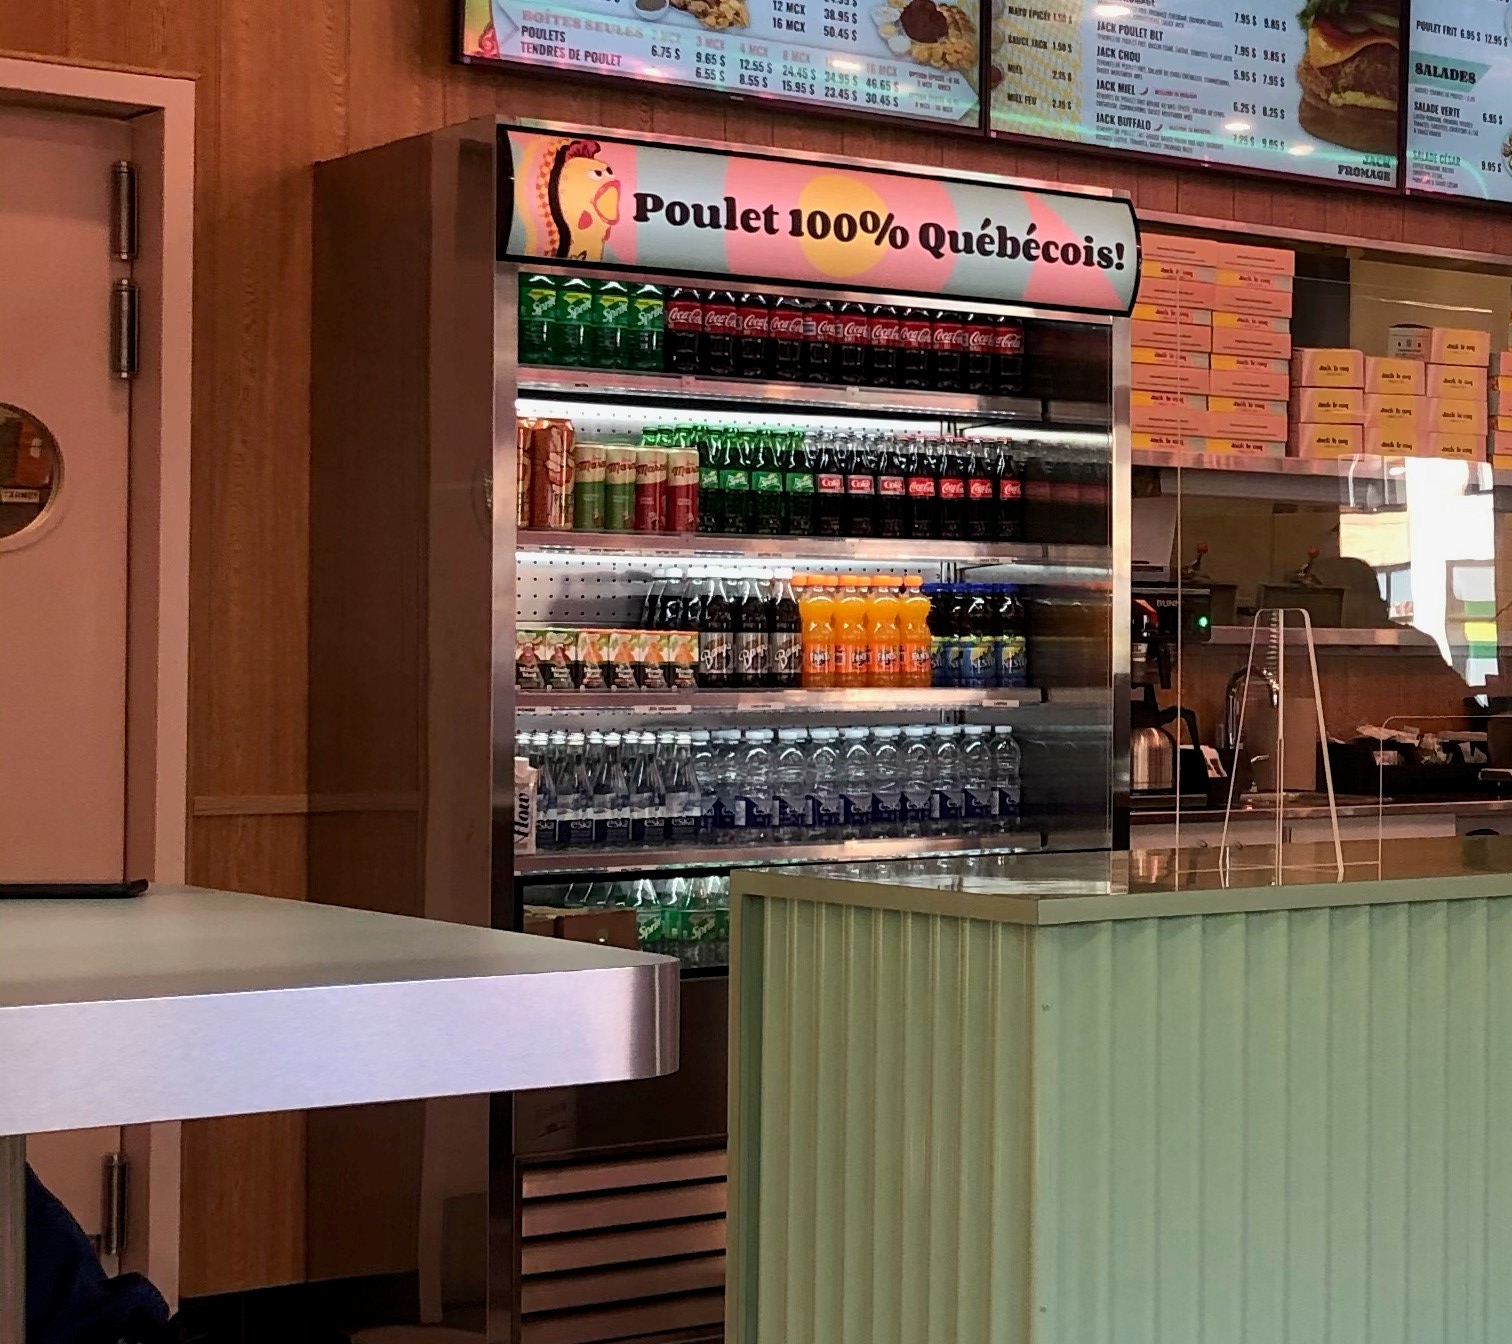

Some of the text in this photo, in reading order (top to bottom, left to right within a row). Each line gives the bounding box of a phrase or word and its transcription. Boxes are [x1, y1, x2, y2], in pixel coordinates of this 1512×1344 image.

[773, 0, 806, 16] 12 MCX
[824, 8, 850, 23] 38.95
[773, 17, 806, 33] 16 MCX
[823, 25, 850, 40] 50.45
[1097, 21, 1116, 35] JACK
[1118, 24, 1148, 39] POULET
[1416, 20, 1457, 38] POULET FRIT
[521, 26, 566, 43] POULETS
[1460, 28, 1475, 41] 6.95
[1484, 33, 1502, 46] 12.95
[520, 41, 622, 68] TENDRES DE POULET
[651, 44, 673, 59] 6.75
[696, 51, 718, 66] 9.65
[1097, 46, 1116, 60] JACK
[1118, 49, 1141, 63] CHOU
[739, 58, 765, 74] 12.55
[782, 64, 808, 79] 24.45
[1415, 62, 1476, 84] SALADES
[695, 67, 717, 81] 6.55
[739, 74, 760, 87] 8.55
[825, 70, 851, 85] 34.95
[782, 79, 807, 94] 15.95
[865, 77, 891, 92] 46.65
[1096, 79, 1136, 96] JACK MIEL
[824, 86, 851, 100] 23.45
[865, 92, 891, 106] 30.45
[1413, 101, 1461, 119] SALADE VERTE
[1096, 112, 1151, 131] JACK BUFFALO
[1337, 164, 1391, 182] FROMAGE
[632, 191, 1126, 271] Poulet 100% Québécois!
